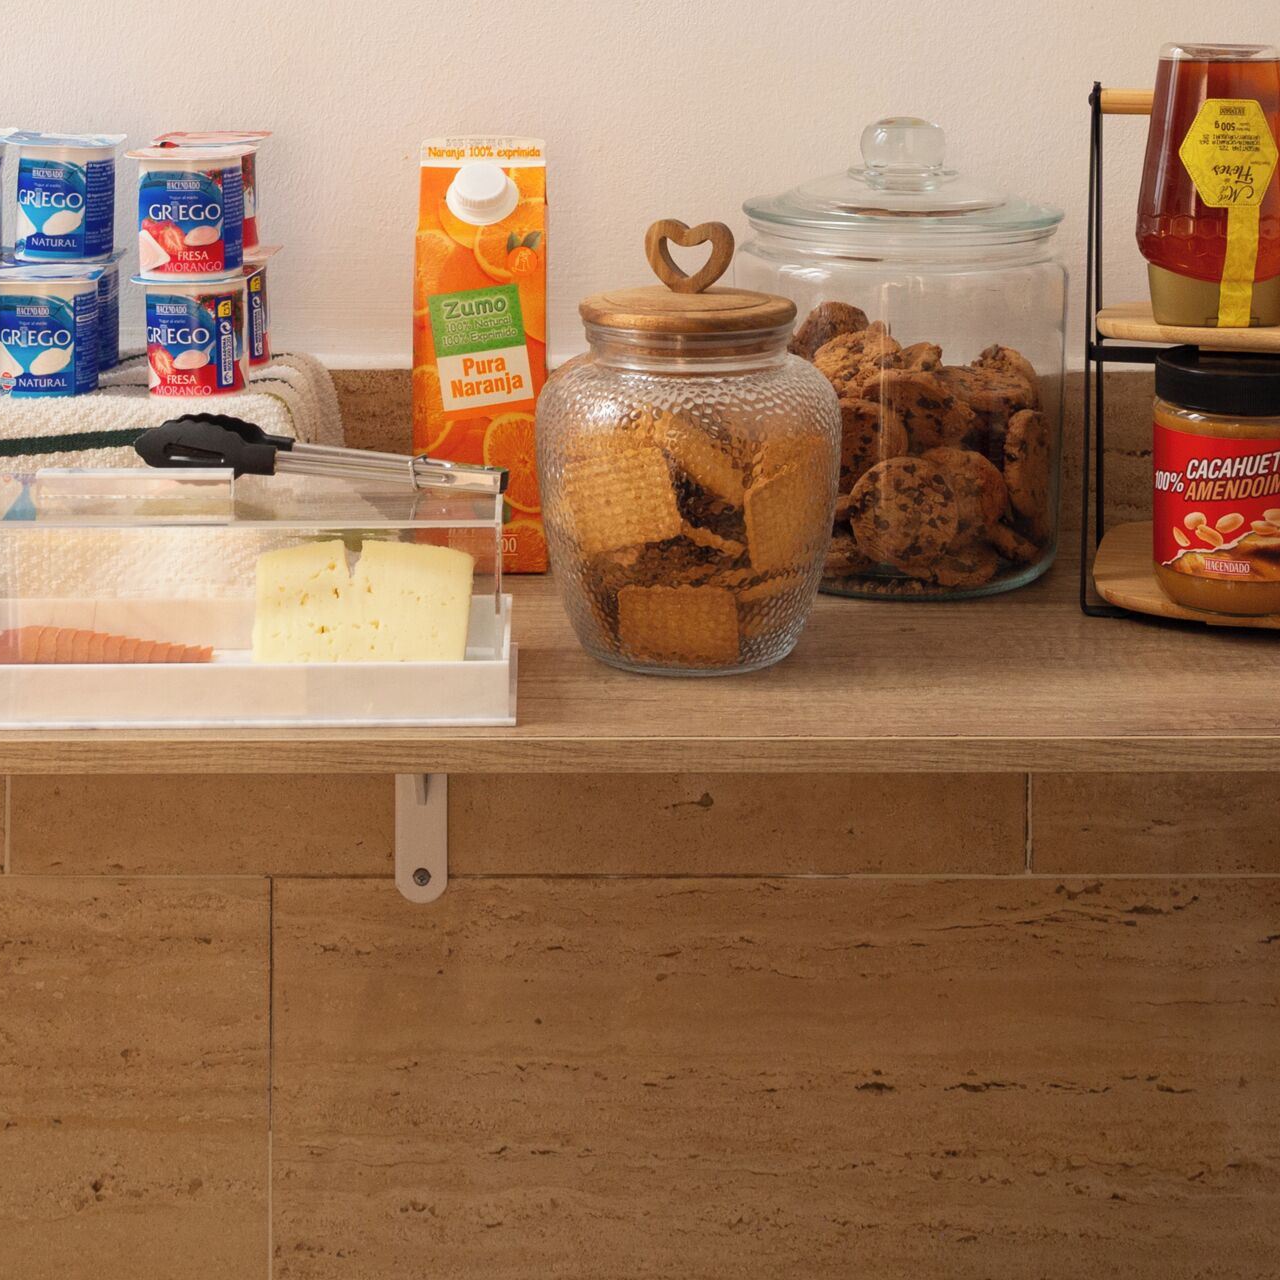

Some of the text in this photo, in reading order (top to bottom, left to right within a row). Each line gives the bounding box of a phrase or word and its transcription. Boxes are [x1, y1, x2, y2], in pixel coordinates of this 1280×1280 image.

[1221, 122, 1236, 131] 500
[427, 145, 541, 160] Naranja 100% exprimida
[1212, 165, 1254, 185] Flores
[19, 188, 83, 209] GRIEGO
[149, 201, 221, 221] GRIEGO
[31, 235, 77, 248] NATURAL
[177, 250, 209, 261] FRESA
[165, 261, 222, 273] MORANGO
[443, 296, 508, 320] Zumo
[446, 313, 512, 334] 100% Natural
[1, 326, 71, 348] GRIEGO
[147, 324, 209, 345] GRIEGO
[443, 326, 518, 347] 100% Exprimido
[462, 357, 507, 377] Pura
[19, 377, 67, 388] NATURAL
[167, 374, 197, 385] FRESA
[450, 372, 524, 399] Naranja
[156, 385, 212, 396] MORANGO
[1154, 470, 1185, 492] 100%
[1204, 558, 1251, 574] HACENDADO
